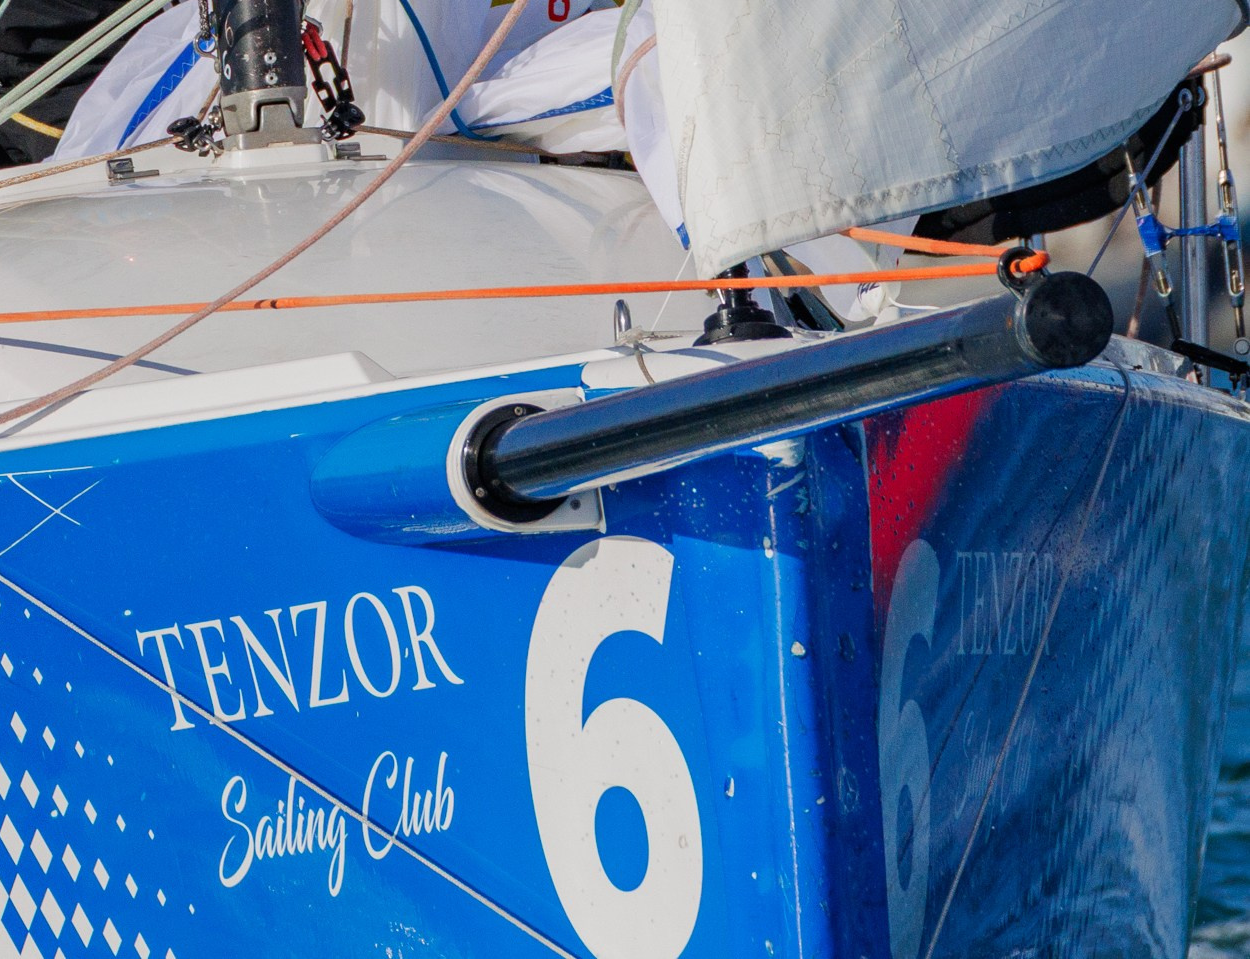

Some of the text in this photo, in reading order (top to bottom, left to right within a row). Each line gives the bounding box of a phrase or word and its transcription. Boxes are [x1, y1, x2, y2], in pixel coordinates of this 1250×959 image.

[136, 585, 464, 731] TENZOR
[956, 552, 1053, 656] TENZOR
[525, 535, 703, 959] 6
[219, 750, 454, 897] Sailing Club
